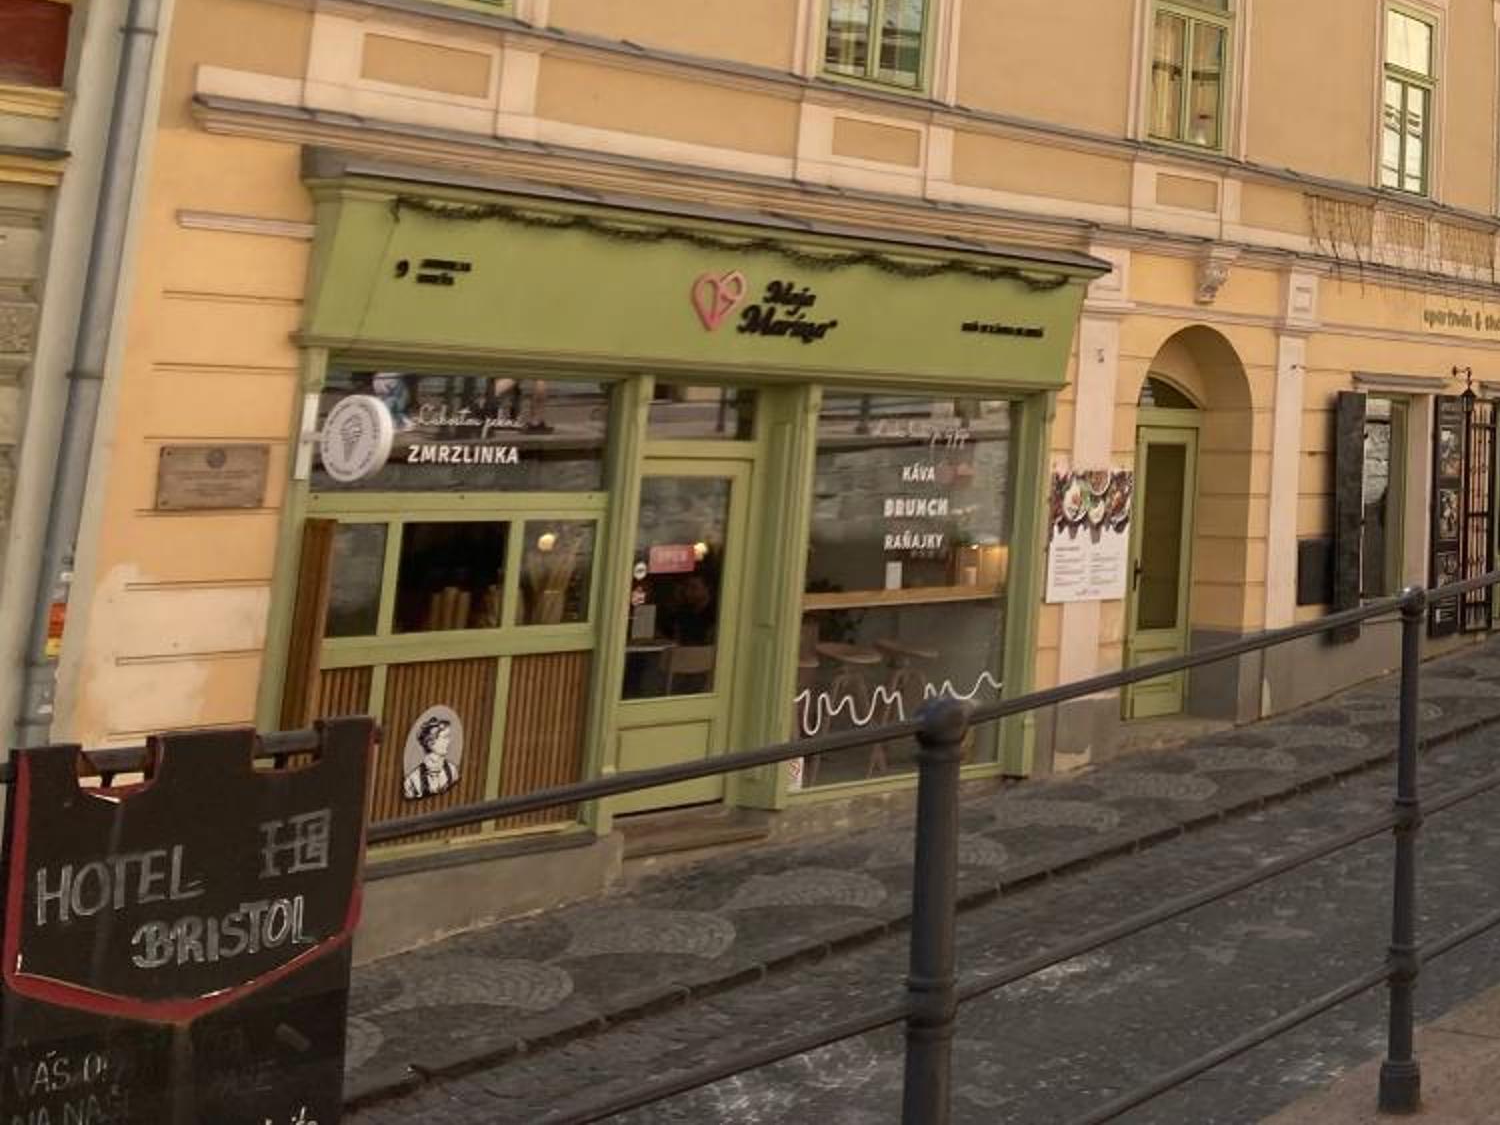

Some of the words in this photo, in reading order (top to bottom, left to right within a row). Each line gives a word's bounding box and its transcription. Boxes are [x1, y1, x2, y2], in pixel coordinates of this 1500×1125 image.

[407, 443, 519, 465] ZMRZLINKA
[902, 462, 935, 482] KÁVA
[884, 498, 948, 517] BRUNCH
[36, 845, 205, 926] HOTEL
[131, 895, 316, 968] BRISTOL
